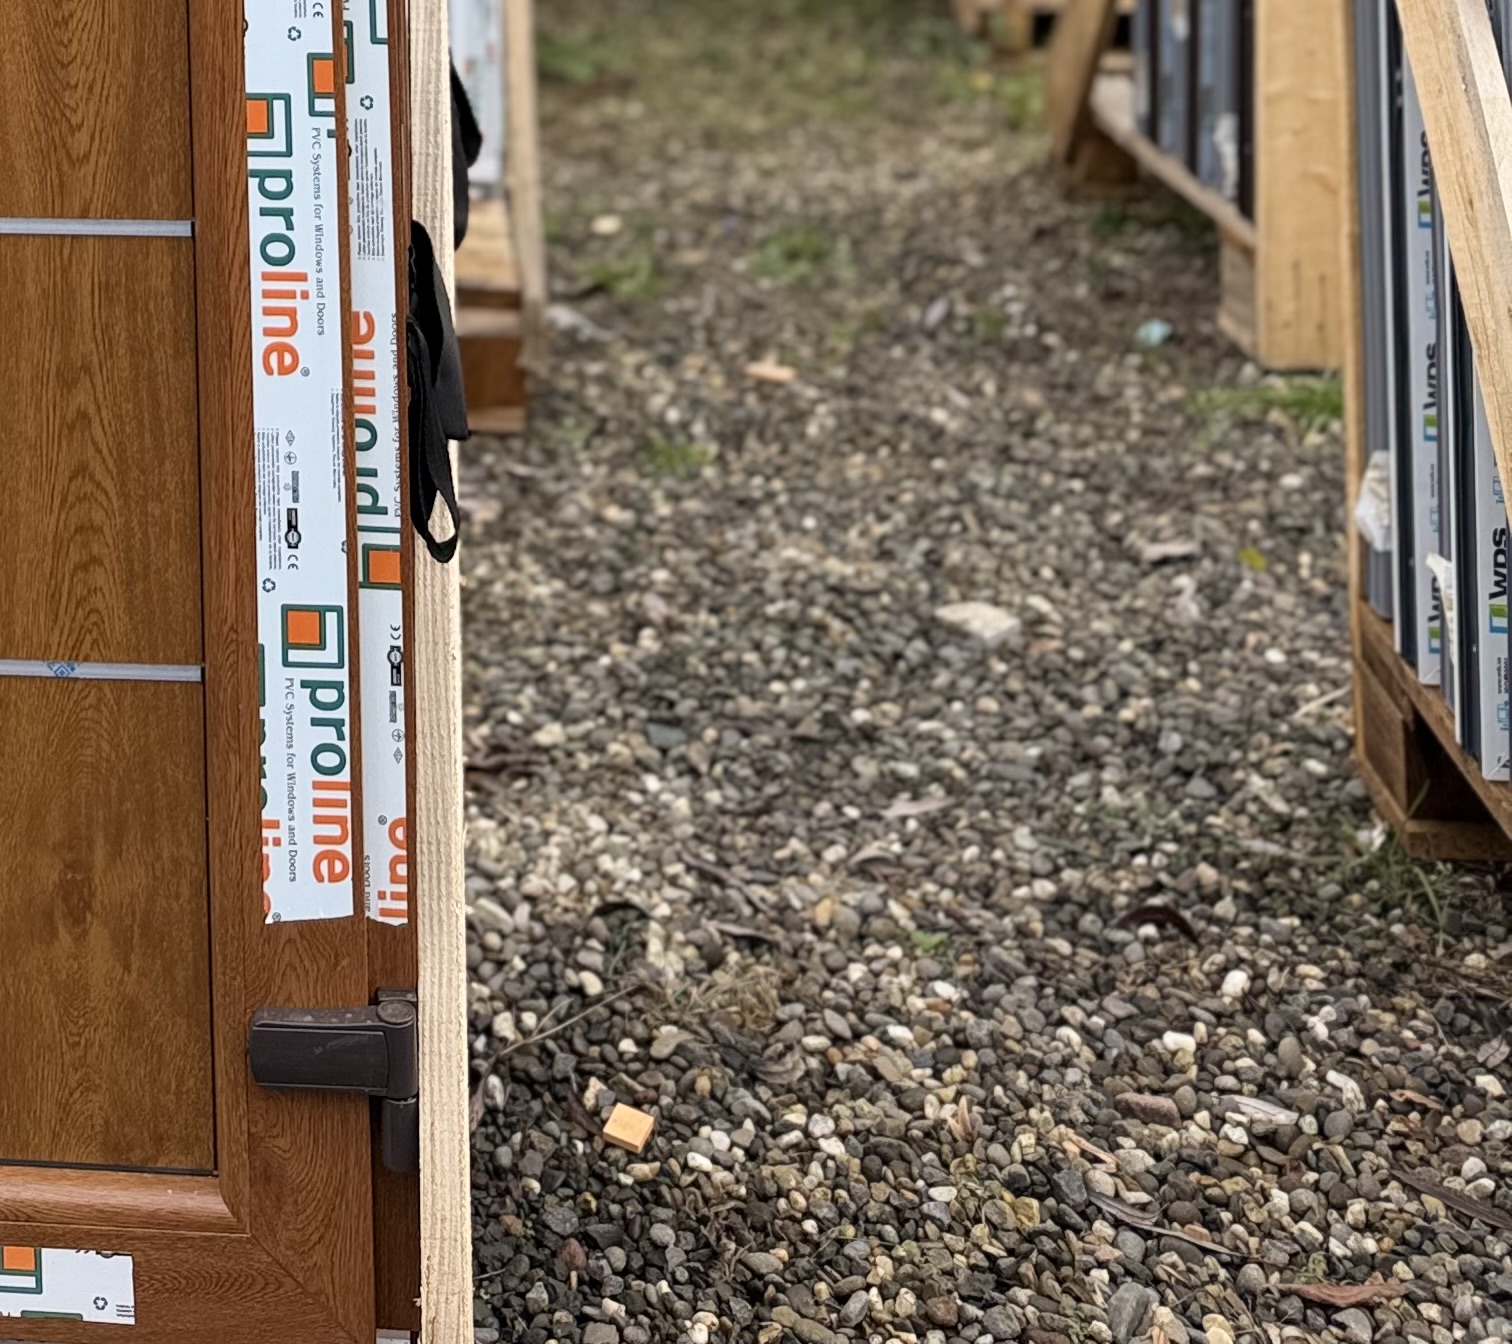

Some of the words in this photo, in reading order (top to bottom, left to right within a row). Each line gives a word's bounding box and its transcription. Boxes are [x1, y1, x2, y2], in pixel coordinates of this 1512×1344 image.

[311, 126, 322, 150] PVC
[309, 152, 322, 200] Systems
[313, 203, 324, 221] for
[314, 223, 324, 274] Windows
[248, 168, 310, 377] proline
[315, 276, 326, 299] and
[316, 302, 326, 336] Doors
[1489, 526, 1509, 601] WDS
[284, 677, 295, 700] PVC
[282, 702, 295, 750] Systems
[286, 752, 297, 769] for
[286, 771, 297, 822] Windows
[300, 679, 351, 884] proline
[287, 824, 298, 846] and
[288, 849, 298, 883] Doors
[377, 817, 408, 919] line
